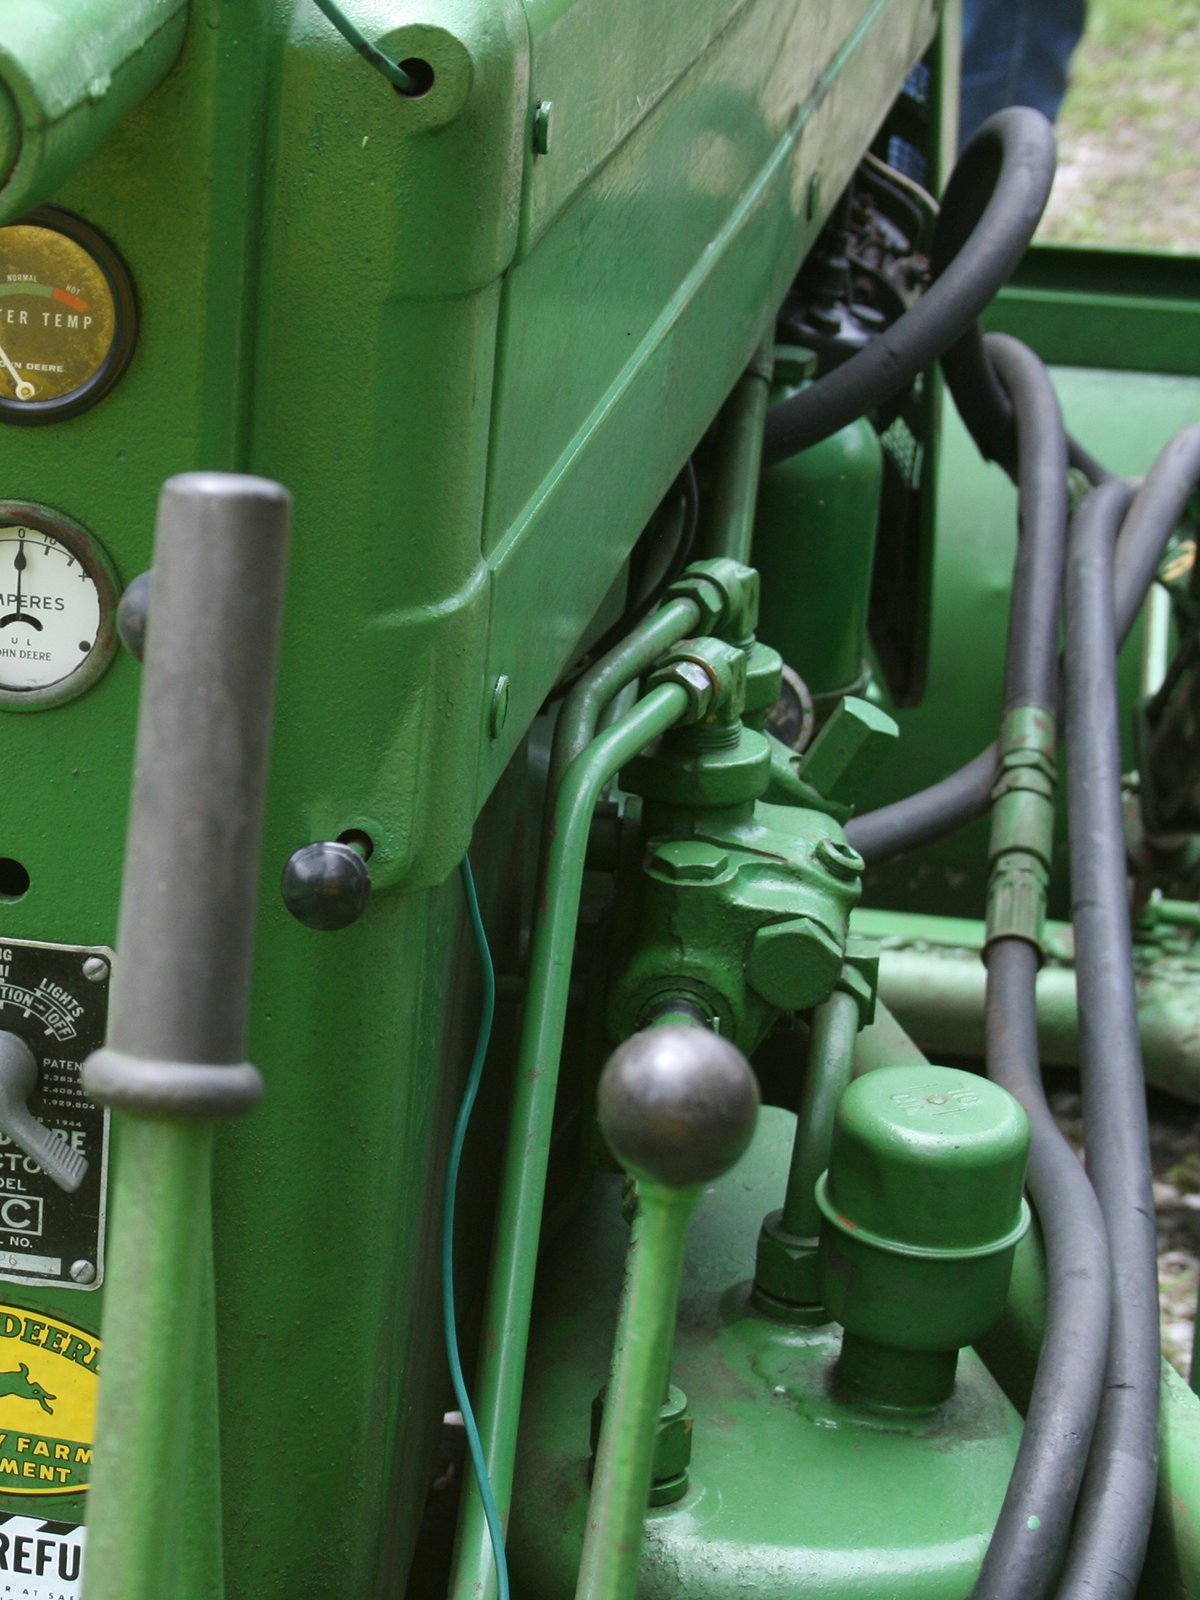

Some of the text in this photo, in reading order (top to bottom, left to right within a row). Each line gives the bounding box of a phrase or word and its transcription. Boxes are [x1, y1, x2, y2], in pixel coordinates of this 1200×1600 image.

[7, 274, 37, 282] NORMAL
[65, 283, 81, 296] HOT
[42, 312, 92, 329] TEMP
[25, 362, 64, 373] DEERE
[17, 527, 26, 539] 0
[11, 637, 18, 645] U
[19, 650, 51, 662] DEERE
[39, 977, 85, 1019] LIGHTS
[48, 1011, 73, 1037] OFF
[43, 1058, 83, 1071] PATEN
[9, 1235, 33, 1249] NO.
[17, 1437, 94, 1465] FARM
[22, 1588, 38, 1597] AT
[48, 1592, 76, 1600] SAF
